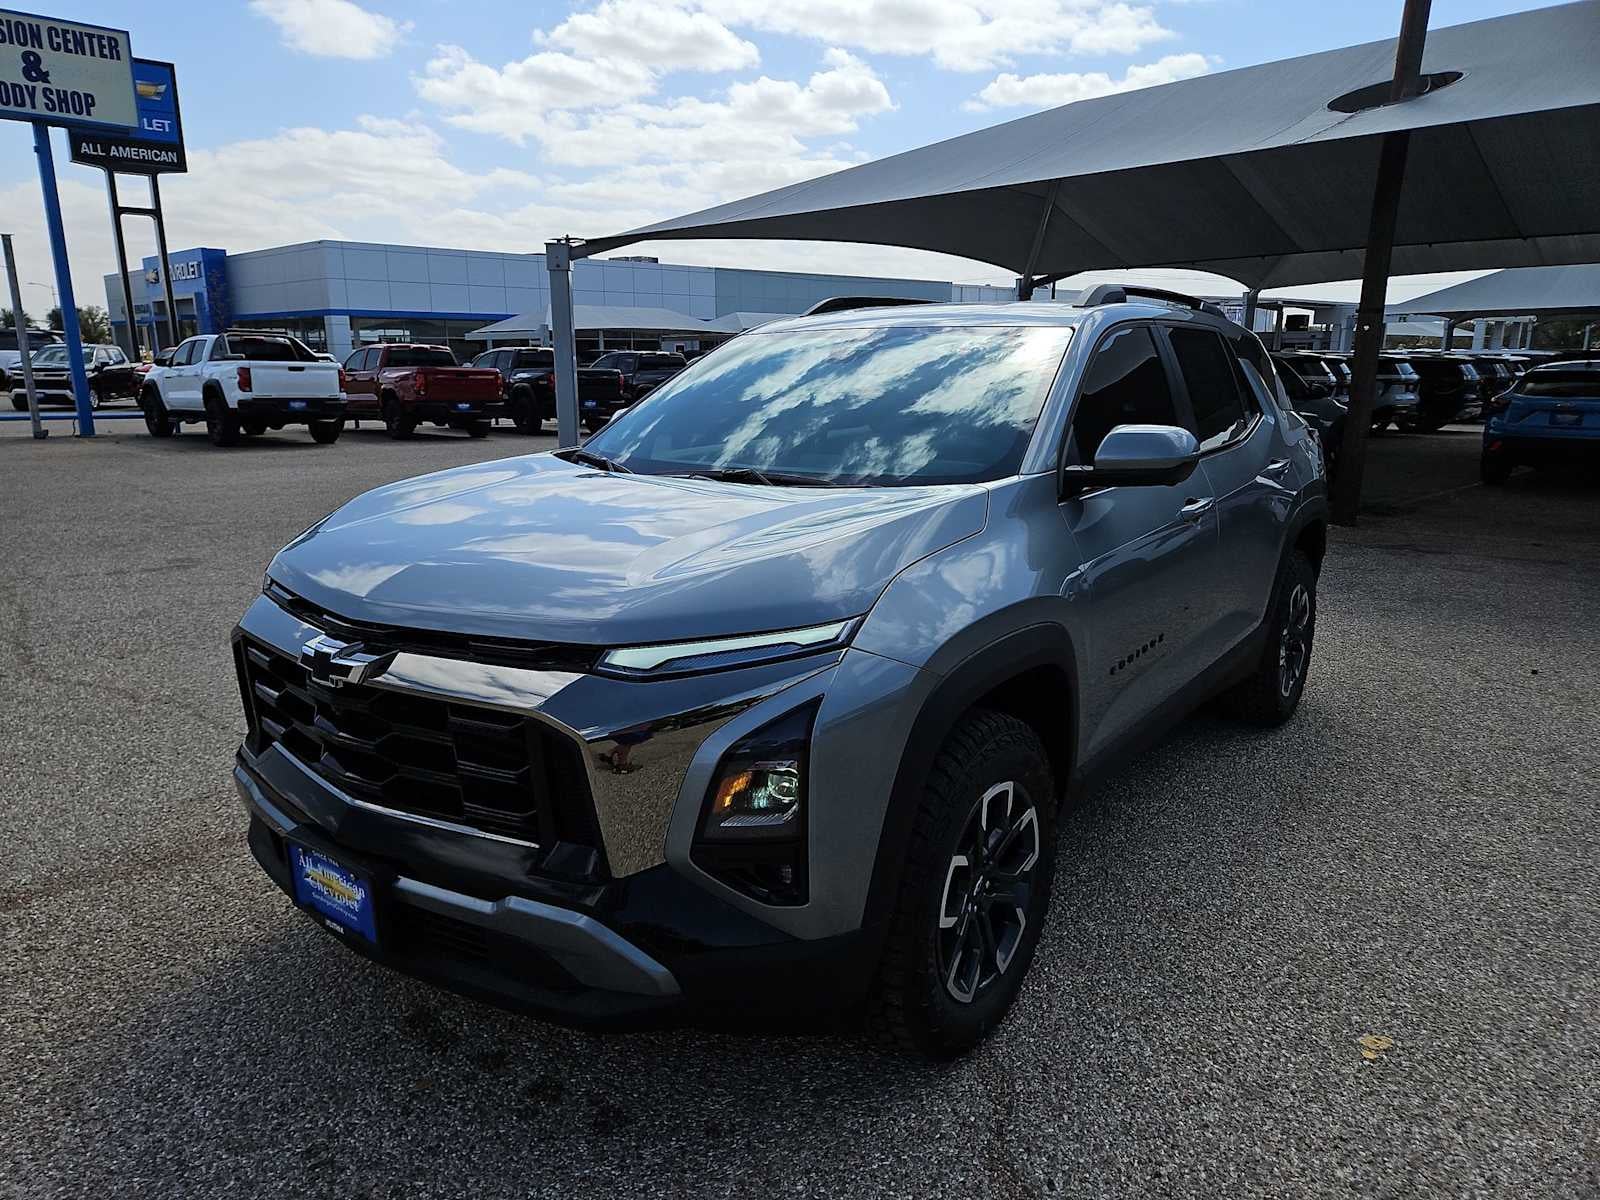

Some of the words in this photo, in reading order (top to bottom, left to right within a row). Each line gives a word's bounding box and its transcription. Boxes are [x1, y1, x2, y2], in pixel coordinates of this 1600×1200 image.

[47, 26, 121, 61] CENTER
[21, 50, 51, 84] &
[42, 87, 96, 117] SHOP
[80, 142, 106, 156] ALL
[110, 146, 178, 163] AMERICAN
